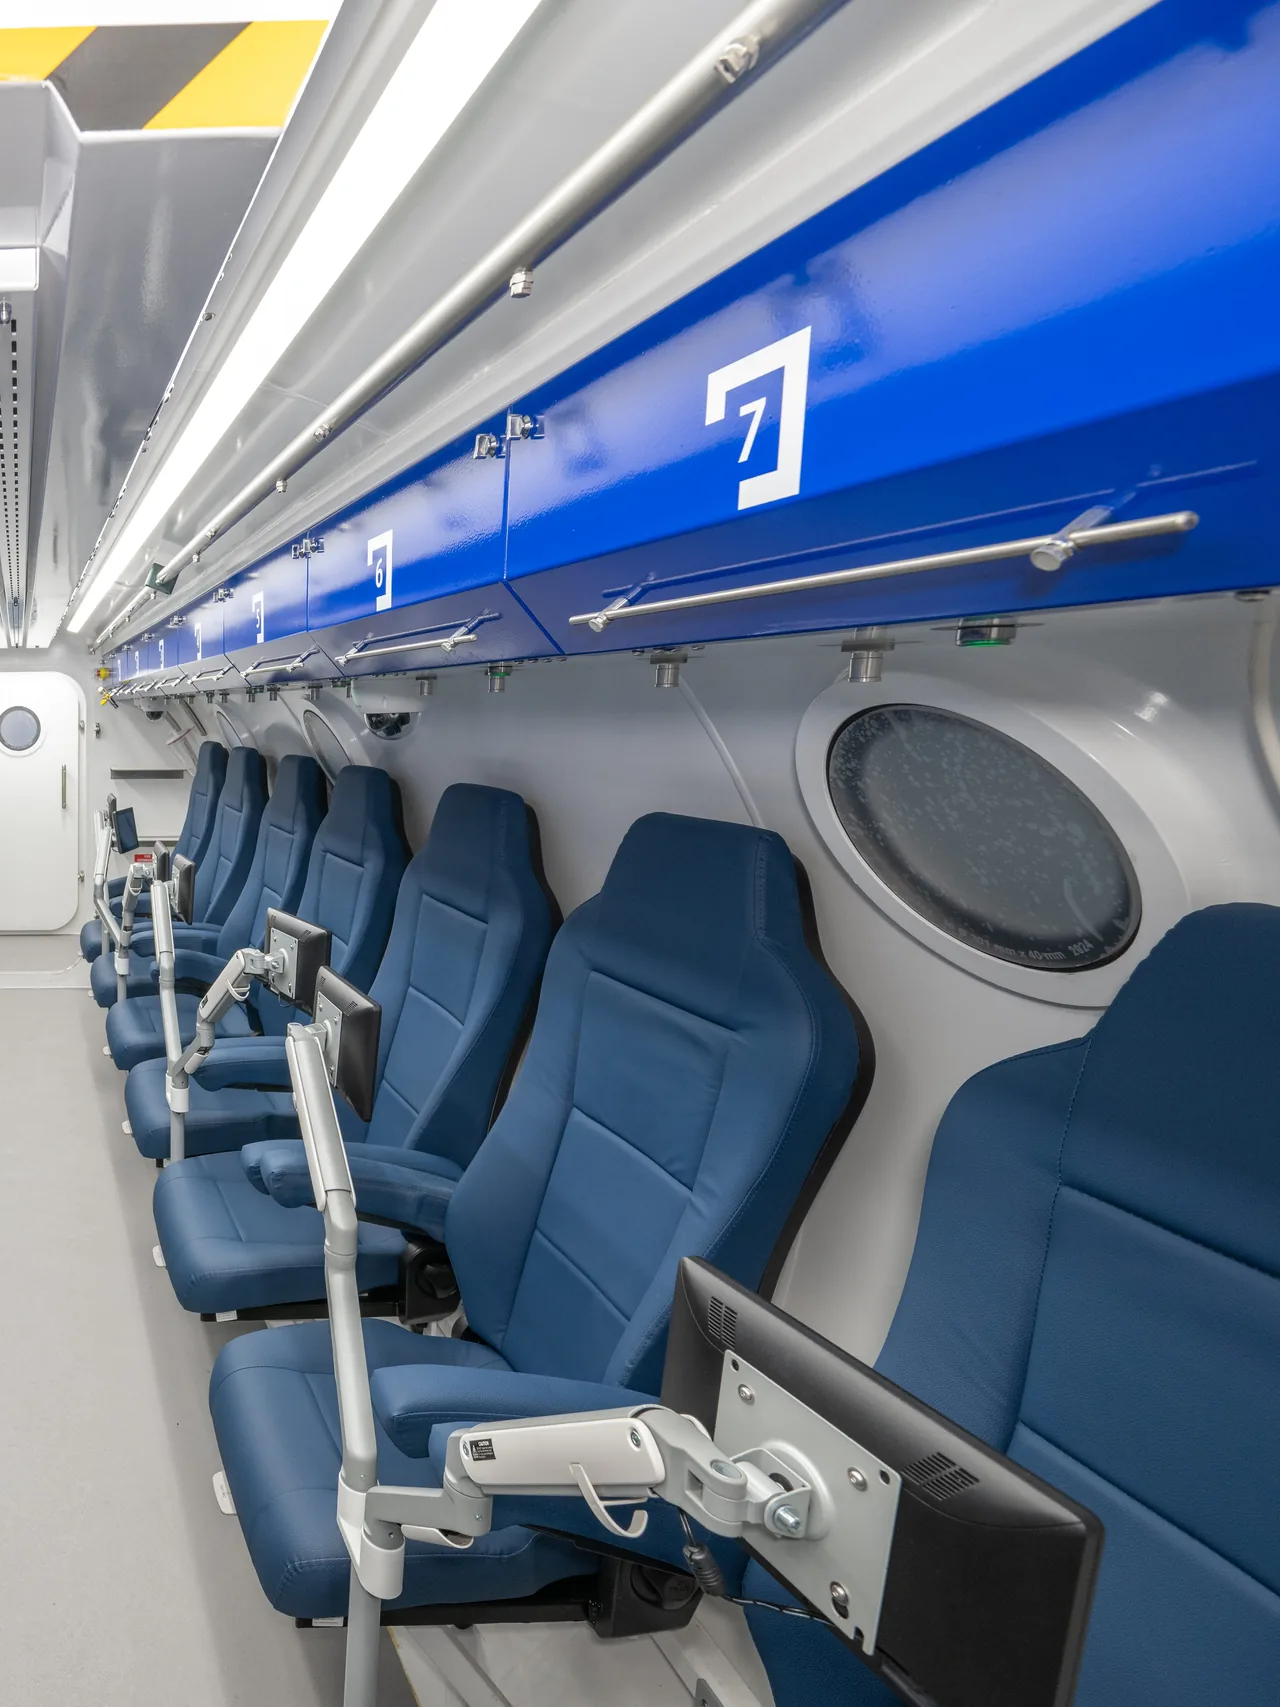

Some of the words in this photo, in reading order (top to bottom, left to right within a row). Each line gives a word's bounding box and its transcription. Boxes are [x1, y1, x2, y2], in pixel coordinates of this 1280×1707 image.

[737, 396, 767, 464] 7
[375, 557, 383, 588] 6
[256, 608, 261, 629] 5
[1067, 938, 1094, 957] 2024
